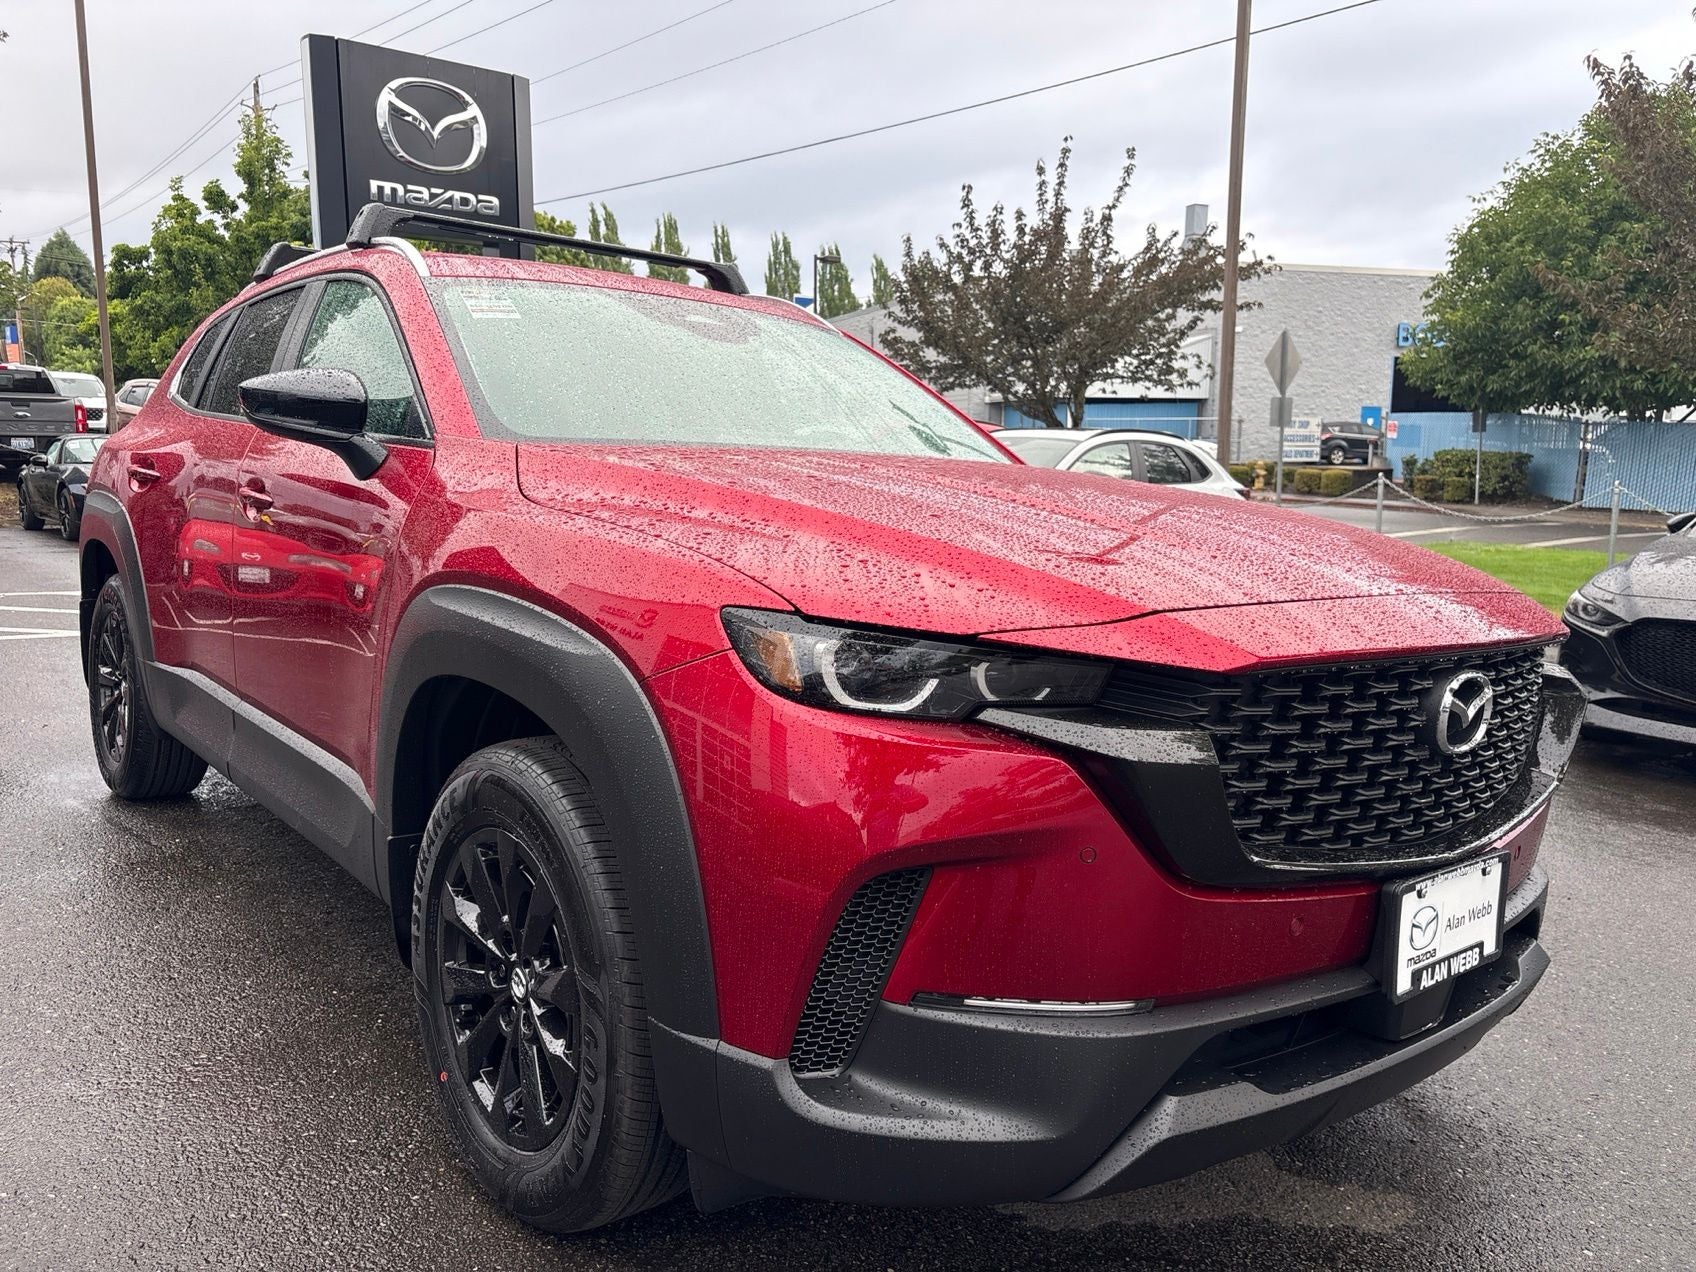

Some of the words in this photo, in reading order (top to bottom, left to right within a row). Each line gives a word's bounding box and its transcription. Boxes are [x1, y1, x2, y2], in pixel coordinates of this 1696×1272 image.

[1444, 914, 1466, 934] Alan
[1468, 900, 1493, 925] Webb
[1419, 960, 1448, 990] ALAN
[1450, 947, 1480, 976] WEBB
